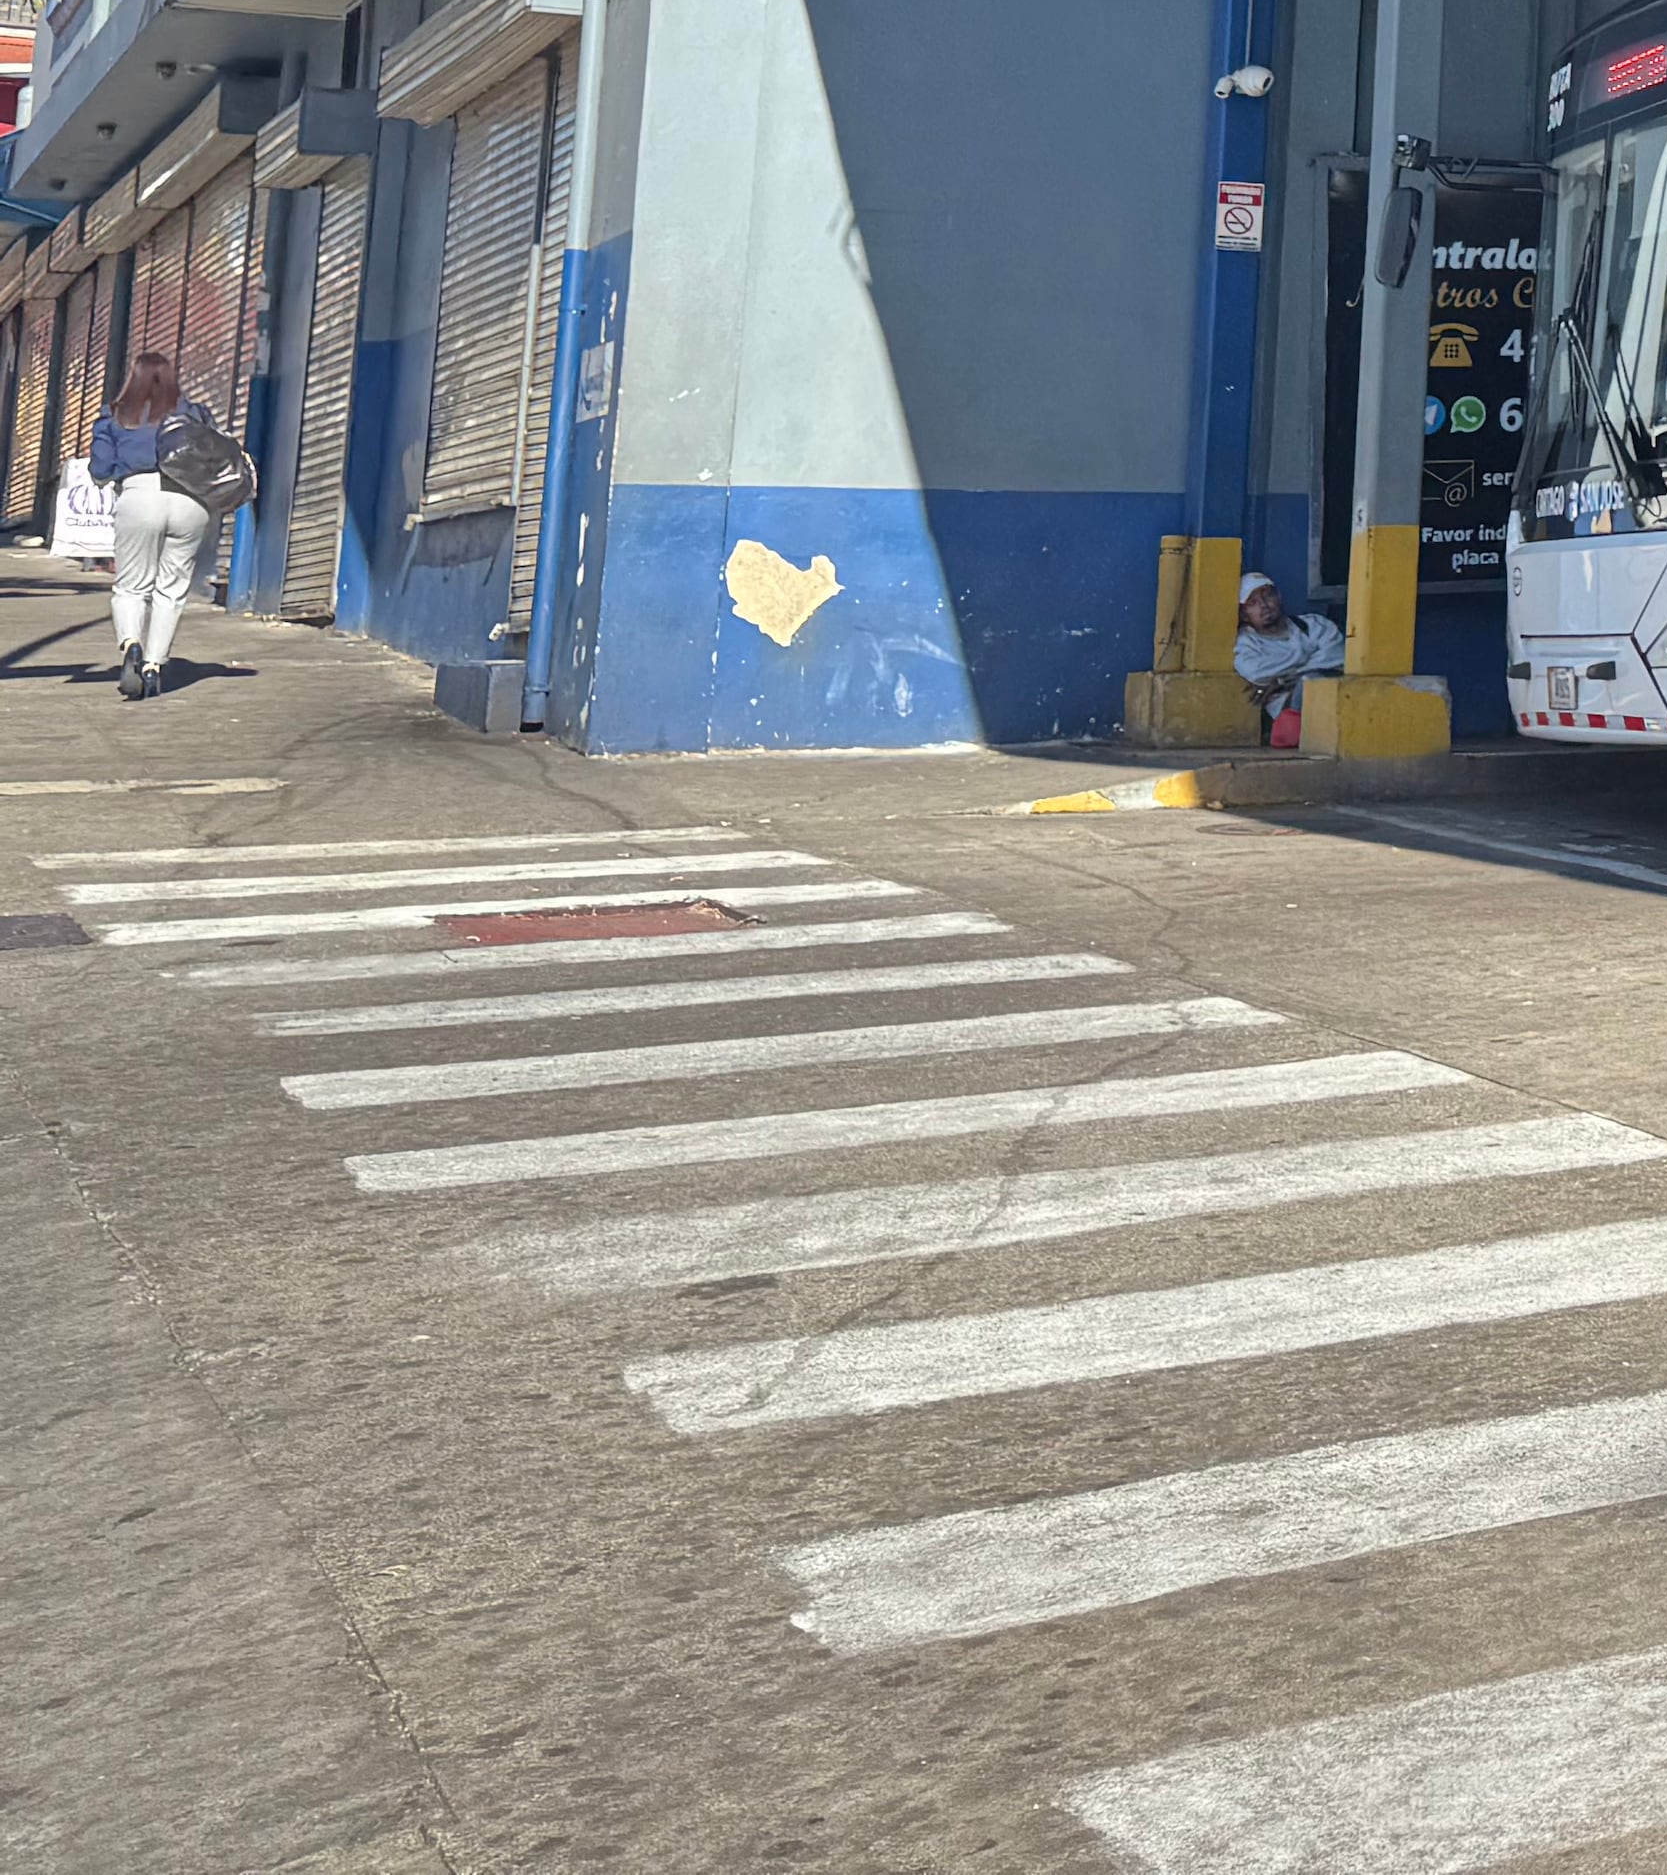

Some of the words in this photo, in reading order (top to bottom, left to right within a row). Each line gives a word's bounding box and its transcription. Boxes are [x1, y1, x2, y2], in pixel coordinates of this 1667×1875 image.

[1431, 237, 1538, 271] ntralo
[1436, 280, 1500, 309] tros
[1499, 397, 1524, 433] 6
[1481, 472, 1514, 486] ser
[1421, 526, 1474, 543] Favor
[1478, 524, 1507, 542] ind
[1451, 549, 1500, 573] placa
